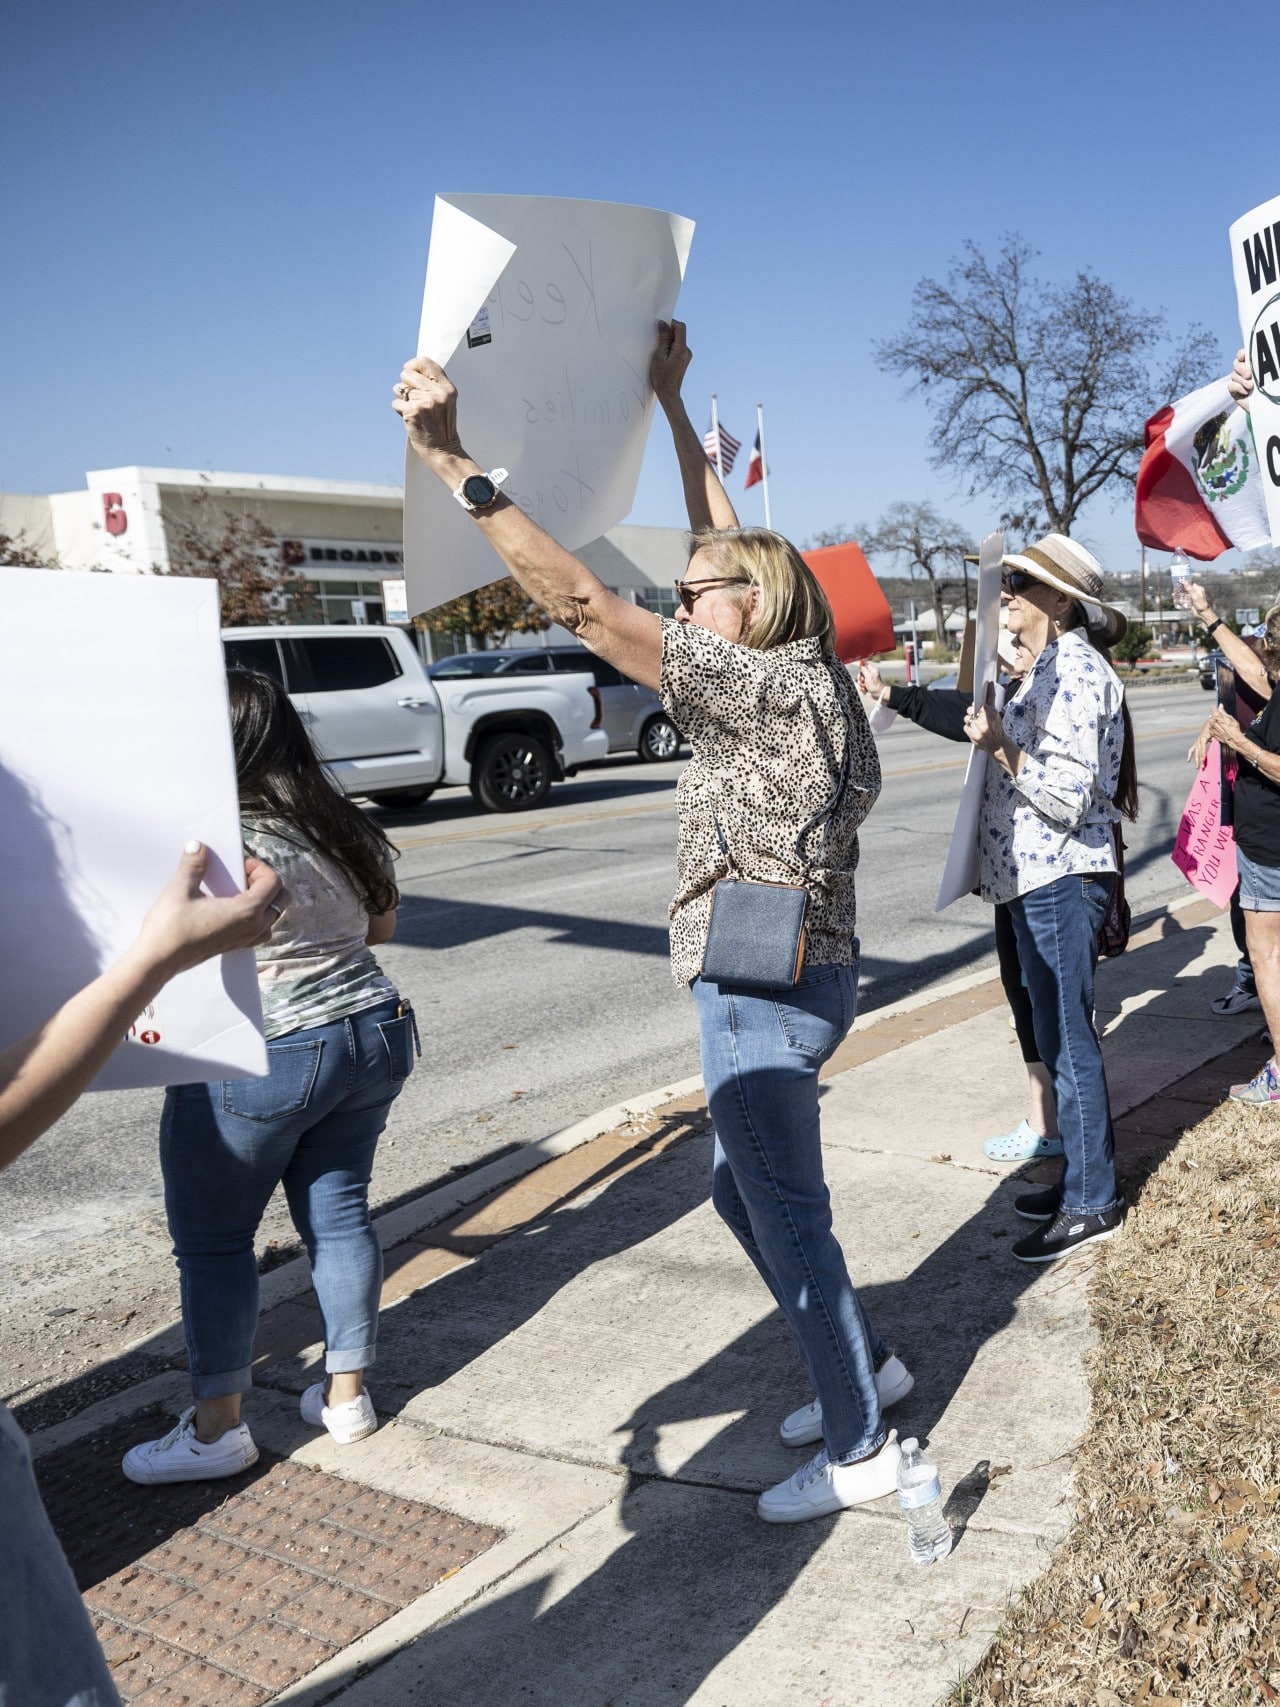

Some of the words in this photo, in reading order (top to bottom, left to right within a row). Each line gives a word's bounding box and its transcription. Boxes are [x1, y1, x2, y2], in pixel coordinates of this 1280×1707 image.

[310, 547, 403, 564] BROADW
[1182, 798, 1202, 835] WAS
[1200, 780, 1210, 794] A
[1186, 799, 1220, 876] STRANGER
[1197, 854, 1221, 886] YOU
[1214, 825, 1233, 851] WE
